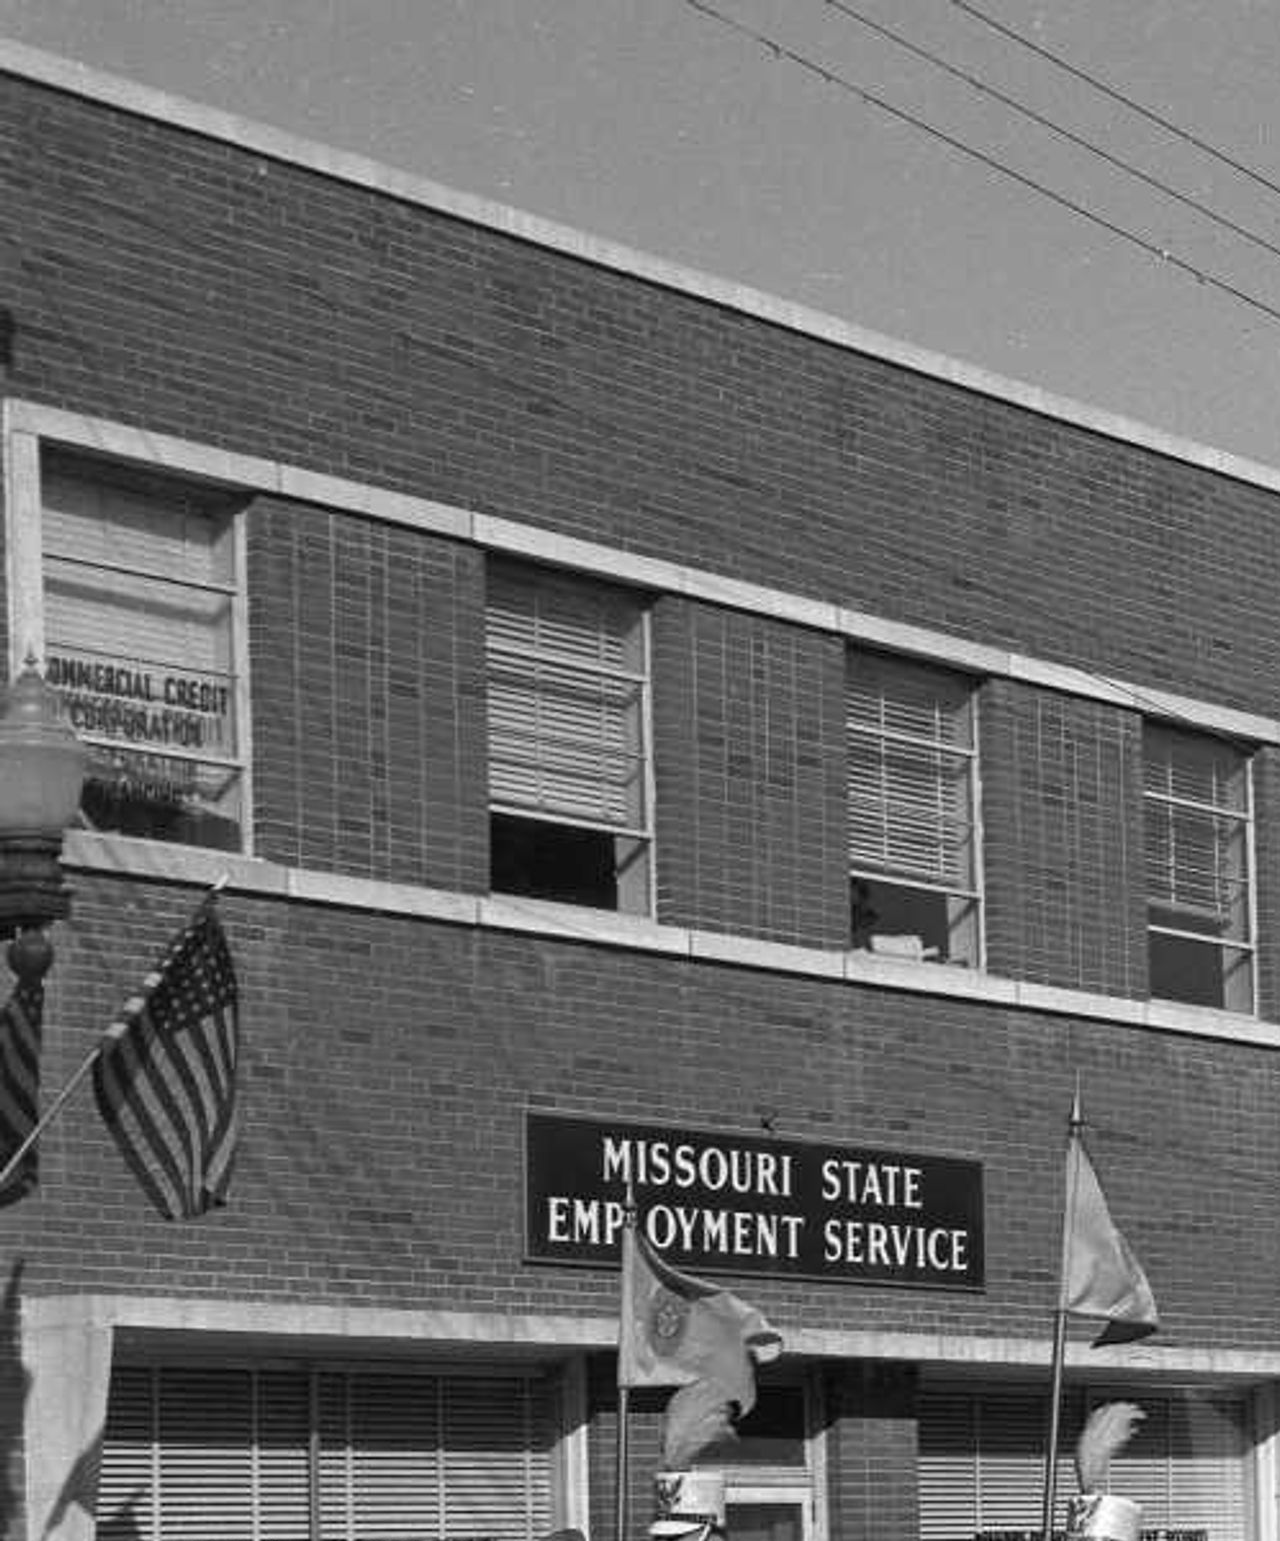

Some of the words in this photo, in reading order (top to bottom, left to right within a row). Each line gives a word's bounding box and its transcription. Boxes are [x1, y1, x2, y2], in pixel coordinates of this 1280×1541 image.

[47, 656, 151, 701] OMMERCIAL
[163, 677, 227, 715] CREDIT
[602, 1136, 793, 1197] MISSOURI
[821, 1159, 924, 1208] STATE
[548, 1196, 805, 1258] EMPOYMENT
[823, 1219, 968, 1270] SERVICE
